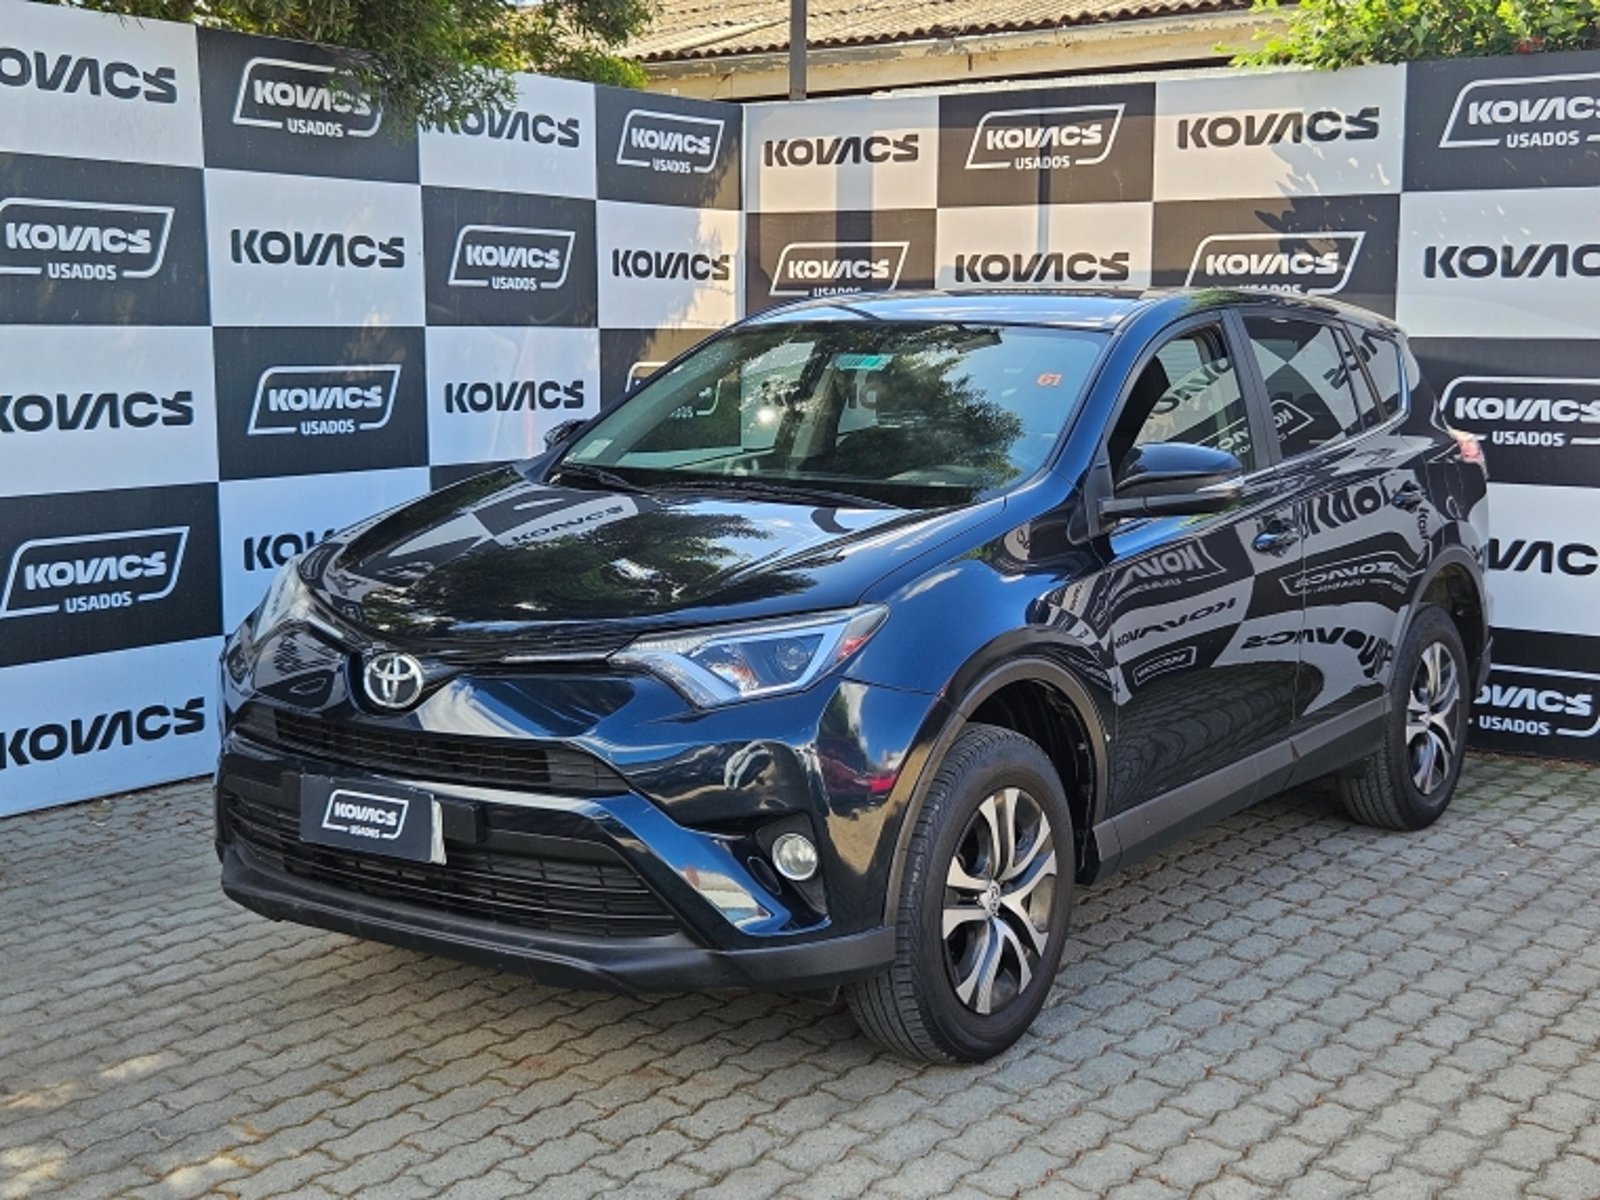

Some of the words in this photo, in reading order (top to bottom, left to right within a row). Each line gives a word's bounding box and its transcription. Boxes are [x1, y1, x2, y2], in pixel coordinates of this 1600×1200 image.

[254, 80, 371, 115] KOVACS
[1469, 97, 1600, 124] KOVAC
[288, 118, 343, 137] USADOS
[987, 124, 1101, 149] KOVACS
[1178, 107, 1379, 149] KOVACS
[1507, 131, 1579, 148] USADOS
[632, 128, 710, 154] KOVACS
[765, 134, 918, 166] KOVACS
[653, 159, 691, 173] USADOS
[1015, 156, 1070, 170] USADOS
[6, 223, 151, 253] KOVACS
[231, 229, 404, 268] KOVACS
[466, 245, 559, 269] KOVACS
[613, 249, 729, 280] KOVACS
[788, 259, 889, 278] KOVACS
[955, 253, 1129, 282] KOVACS
[1206, 253, 1338, 275] KOVACS
[48, 263, 116, 280] USADOS
[492, 277, 537, 290] USADOS
[1239, 284, 1302, 293] DOS
[269, 386, 382, 411] KOVACS
[445, 381, 584, 413] KOVACS
[301, 419, 355, 435] USADOS
[1493, 431, 1564, 446] USADOS
[25, 551, 167, 590] KOVACS
[65, 591, 132, 613] USADOS
[0, 697, 204, 770] KOVACS
[1480, 716, 1550, 735] USADOS
[334, 802, 398, 826] KOVACS
